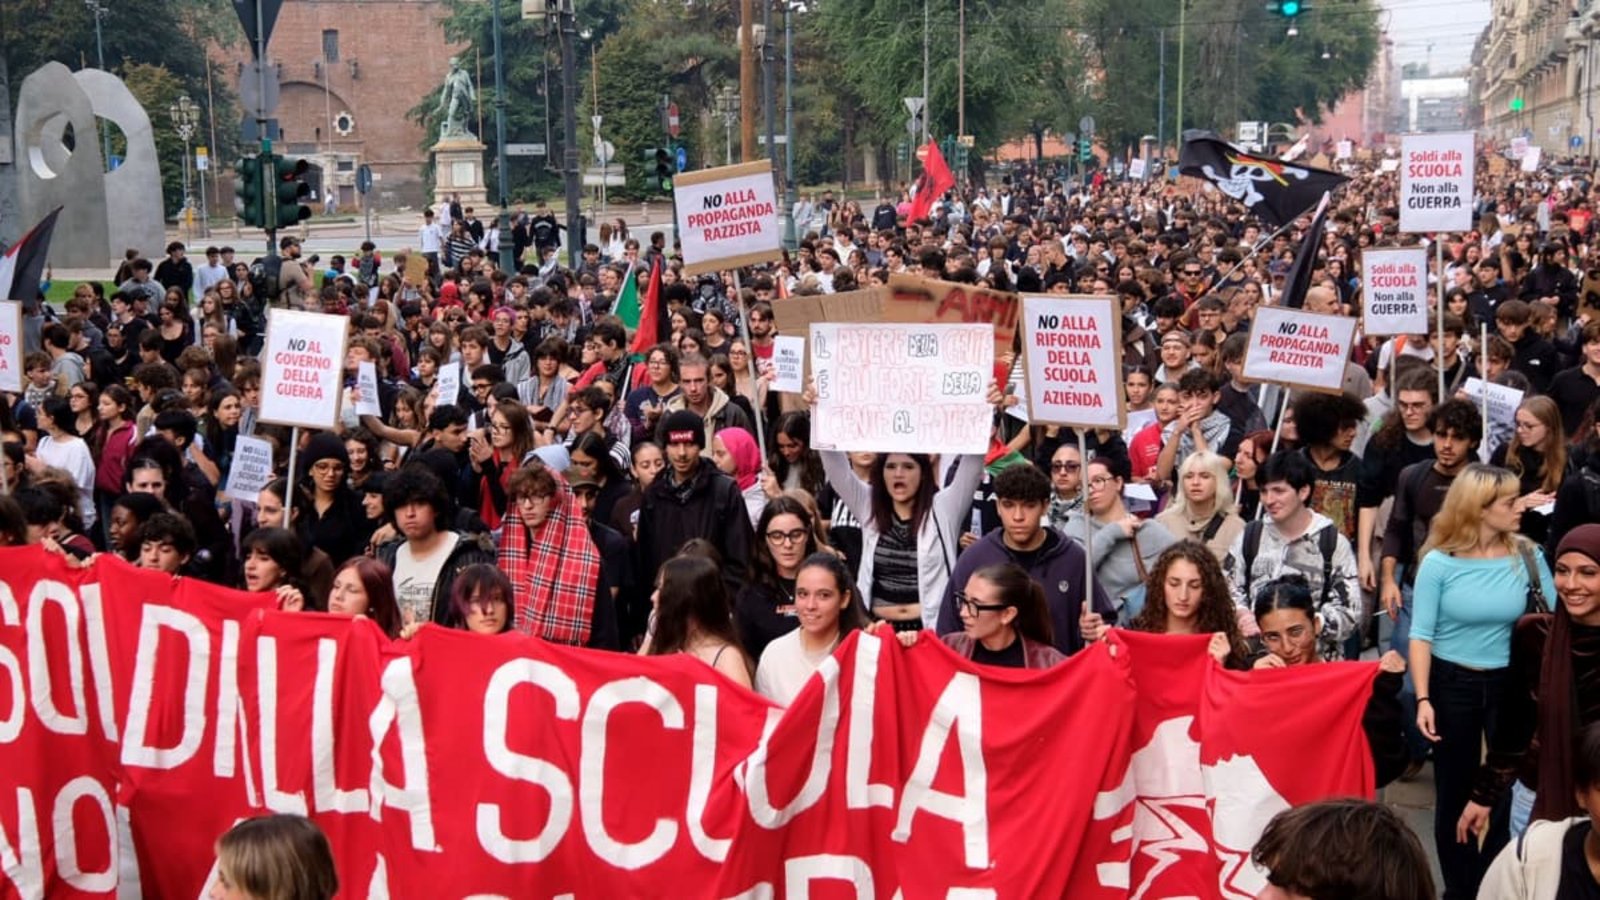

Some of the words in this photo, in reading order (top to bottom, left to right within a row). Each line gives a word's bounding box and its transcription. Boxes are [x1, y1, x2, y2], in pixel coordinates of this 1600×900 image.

[1409, 150, 1438, 162] Soldi
[1440, 150, 1462, 161] alla
[1408, 164, 1462, 178] SCUOLA
[1411, 183, 1435, 194] Non
[1437, 182, 1458, 193] alla
[703, 194, 722, 209] NO
[724, 189, 756, 206] ALLA
[1408, 196, 1462, 209] GUERRA
[687, 202, 774, 228] PROPAGANDA
[703, 221, 762, 242] RAZZISTA
[1371, 264, 1396, 275] Soldi
[1398, 264, 1416, 274] alla
[1371, 276, 1417, 288] SCUOLA
[1374, 292, 1394, 302] Non
[1396, 291, 1414, 301] alla
[1371, 303, 1418, 315] GUERRA
[1038, 315, 1059, 330] NO
[1061, 315, 1097, 331] ALLA
[1278, 321, 1298, 335] NO
[1298, 324, 1329, 339] ALLA
[287, 338, 306, 351] NO
[307, 341, 322, 354] AL
[908, 333, 938, 357] DELLA
[1036, 332, 1101, 349] RIFORMA
[1260, 334, 1341, 356] PROPAGANDA
[275, 352, 332, 370] GOVERNO
[1047, 350, 1091, 366] DELLA
[1269, 350, 1324, 369] RAZZISTA
[282, 368, 320, 384] DELLA
[942, 371, 982, 396] DELLA
[1044, 367, 1098, 384] SCUOLA
[276, 383, 323, 400] GUERRA
[1043, 390, 1103, 408] AZIENDA
[893, 409, 915, 435] AL
[237, 635, 442, 852] LLA
[476, 629, 992, 869] SCUOLA
